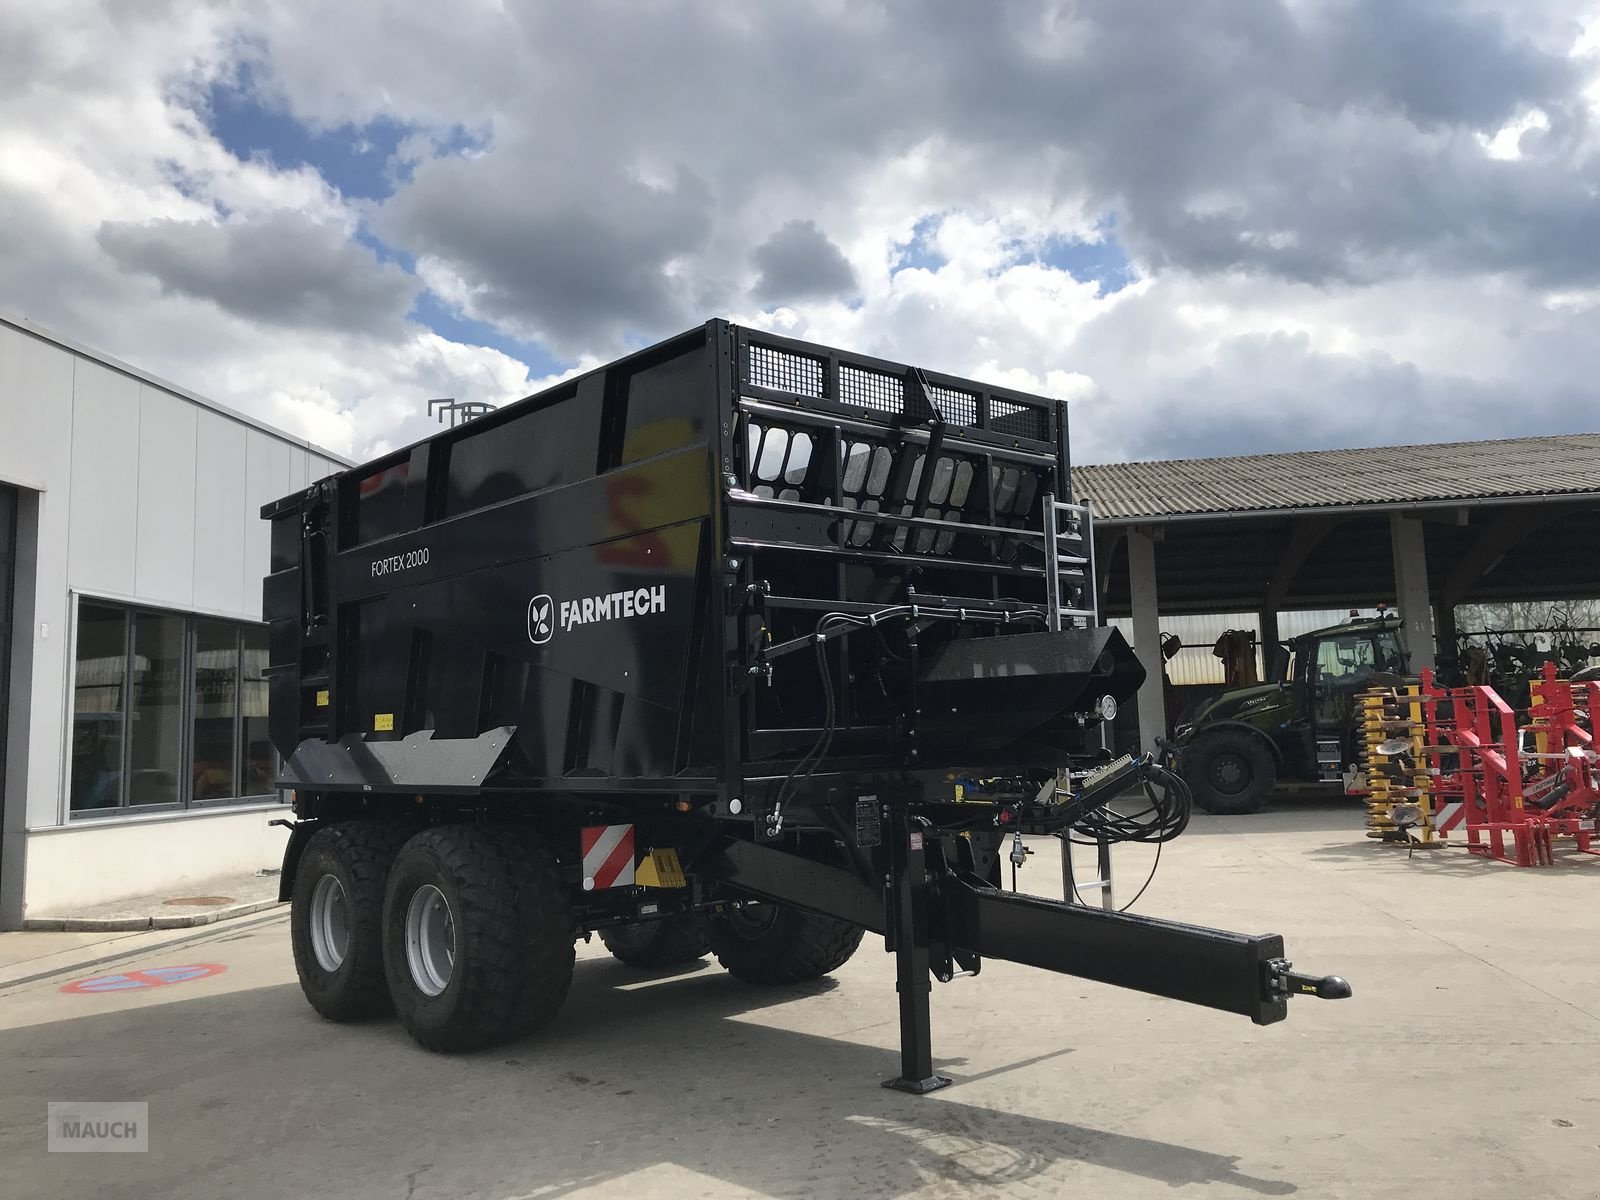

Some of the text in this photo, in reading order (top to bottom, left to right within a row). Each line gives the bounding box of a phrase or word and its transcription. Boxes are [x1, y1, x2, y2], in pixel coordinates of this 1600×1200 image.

[371, 547, 430, 577] FORTEX 2000
[560, 584, 666, 632] FARMTECH
